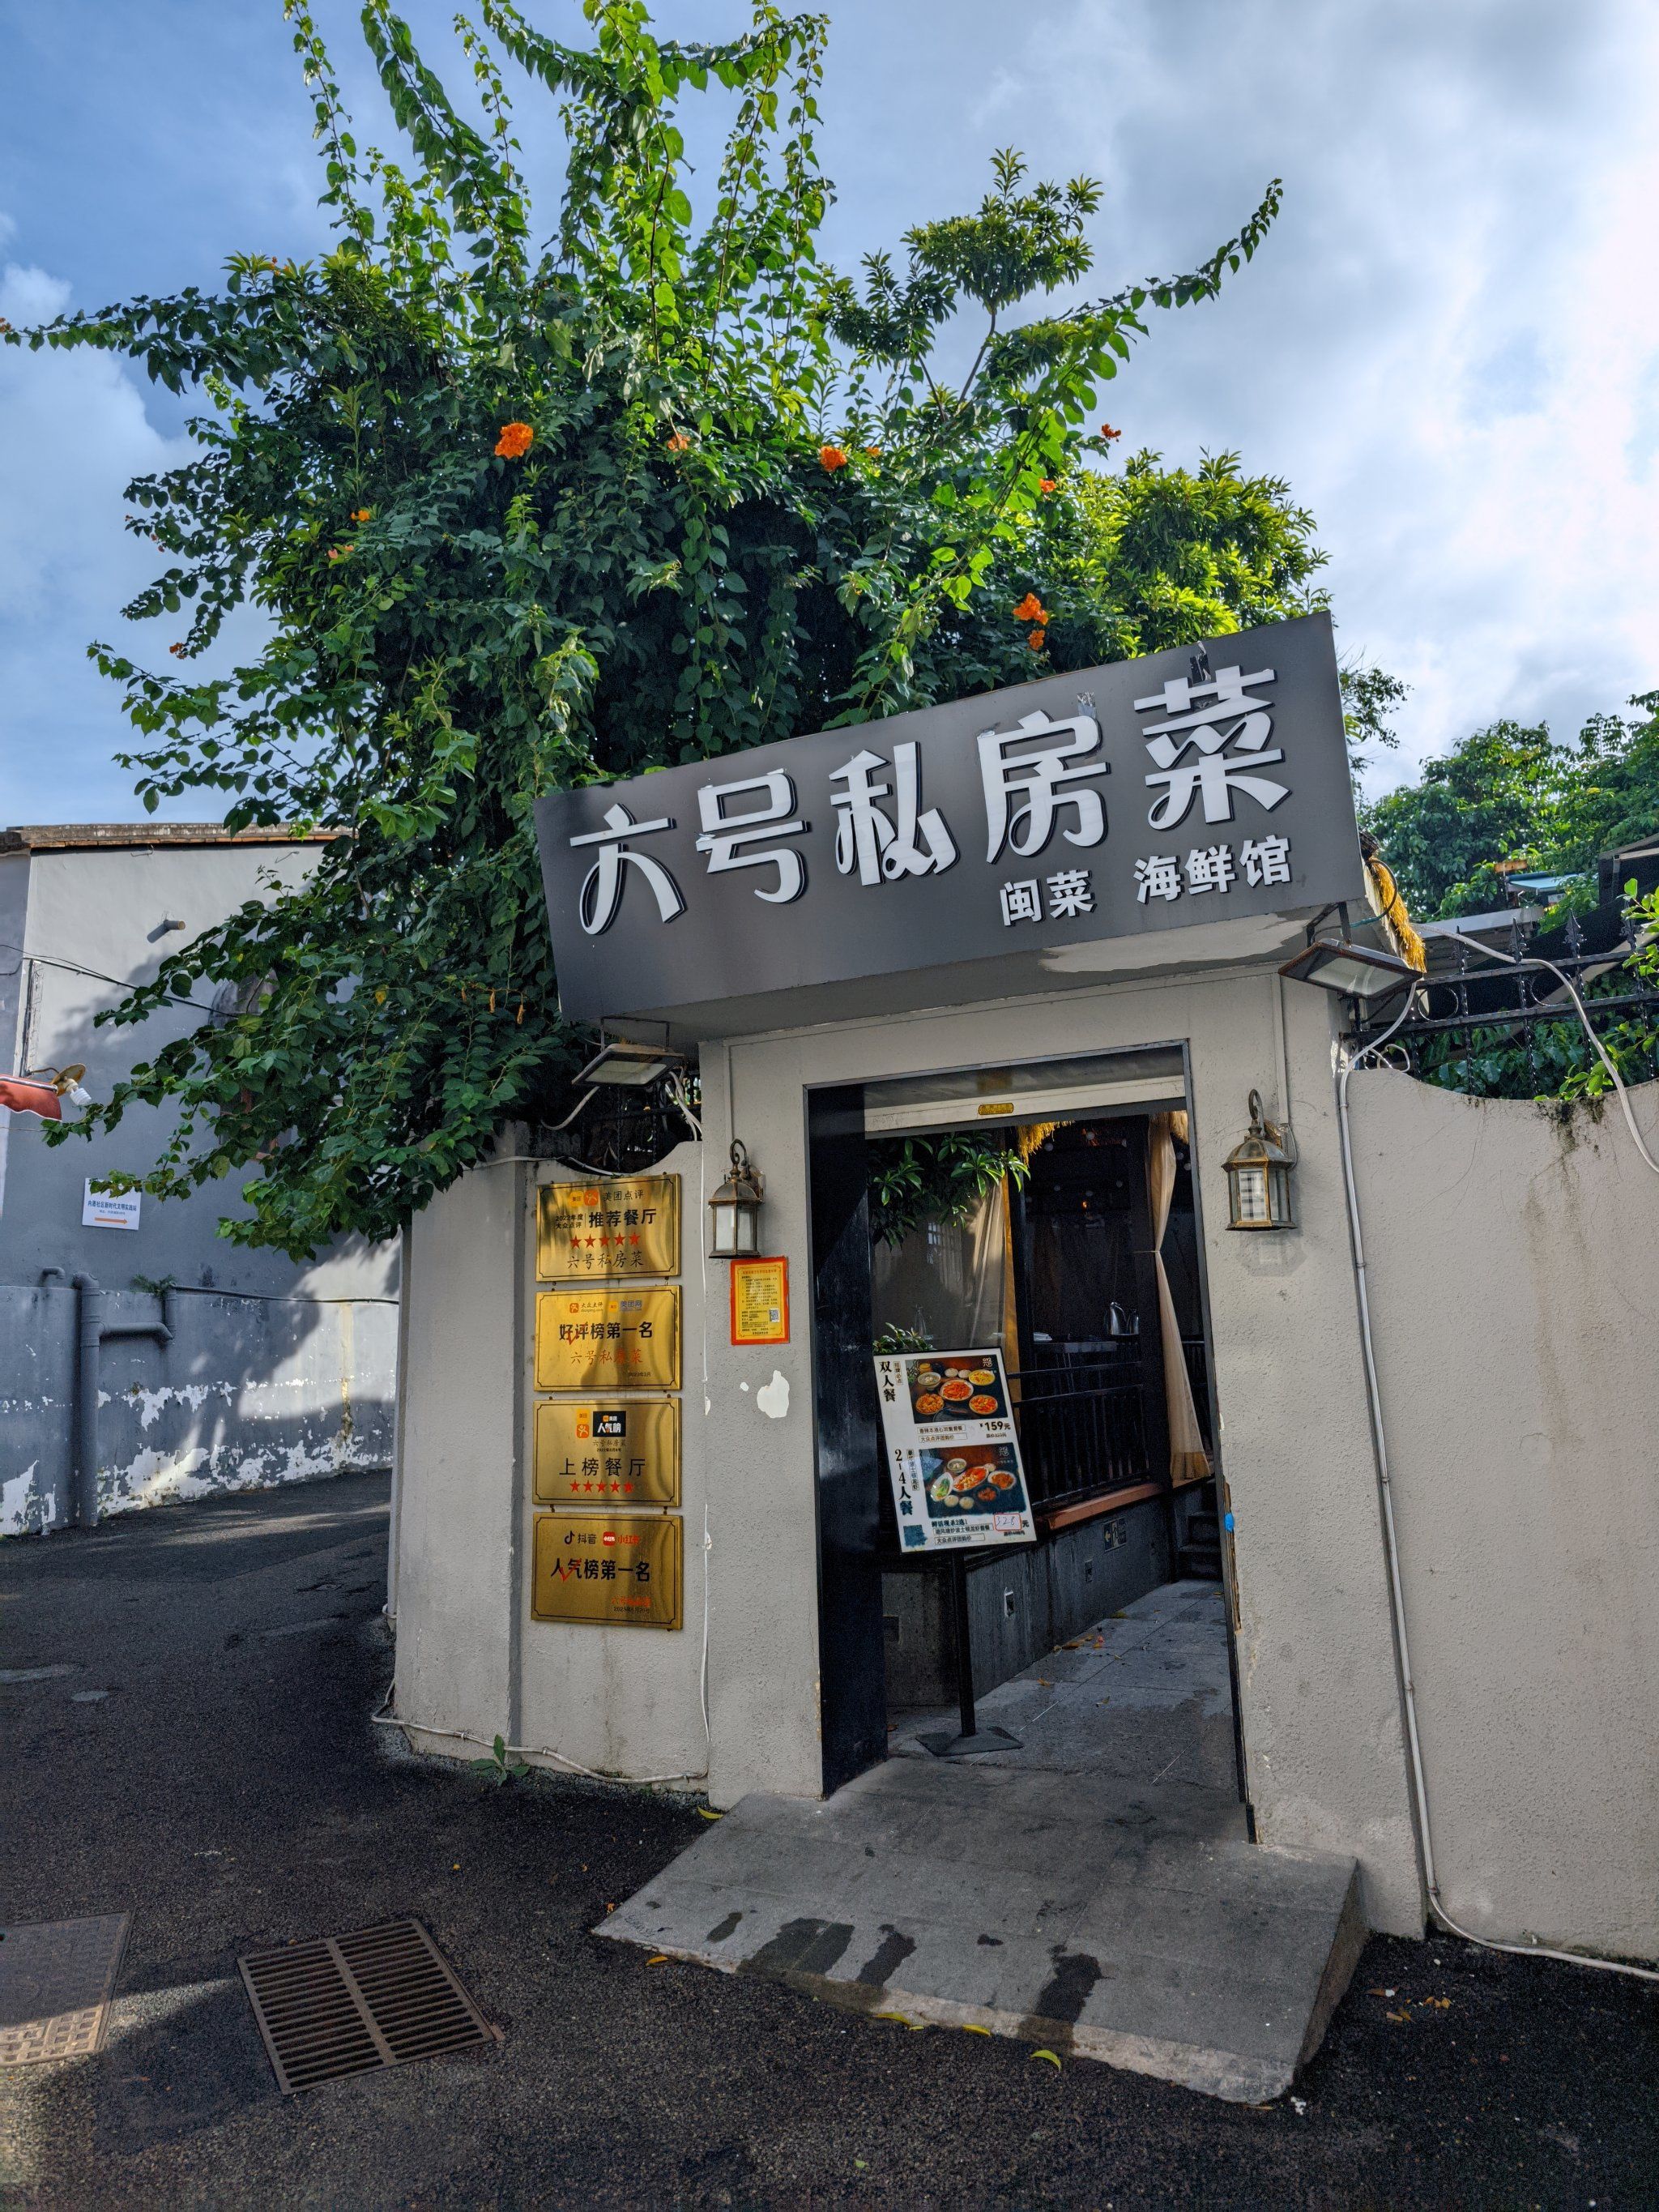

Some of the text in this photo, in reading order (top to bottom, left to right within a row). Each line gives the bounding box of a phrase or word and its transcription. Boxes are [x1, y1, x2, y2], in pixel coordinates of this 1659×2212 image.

[569, 665, 1292, 935] 六号私房菜
[1000, 835, 1292, 926] 闽菜 海鲜馆
[603, 1189, 644, 1201] 美团点评
[556, 1214, 583, 1222] 2022年度
[556, 1221, 582, 1229] 大众点评
[589, 1208, 657, 1228] 推荐餐厅
[567, 1250, 645, 1270] 六号私房菜
[559, 1322, 653, 1341] 好评榜第一名
[879, 1361, 896, 1402] 双人餐
[597, 1423, 621, 1433] 人气榜
[559, 1458, 646, 1476] 上榜餐厅
[578, 1533, 596, 1544] 抖音
[551, 1557, 650, 1582] 人气榜第一名
